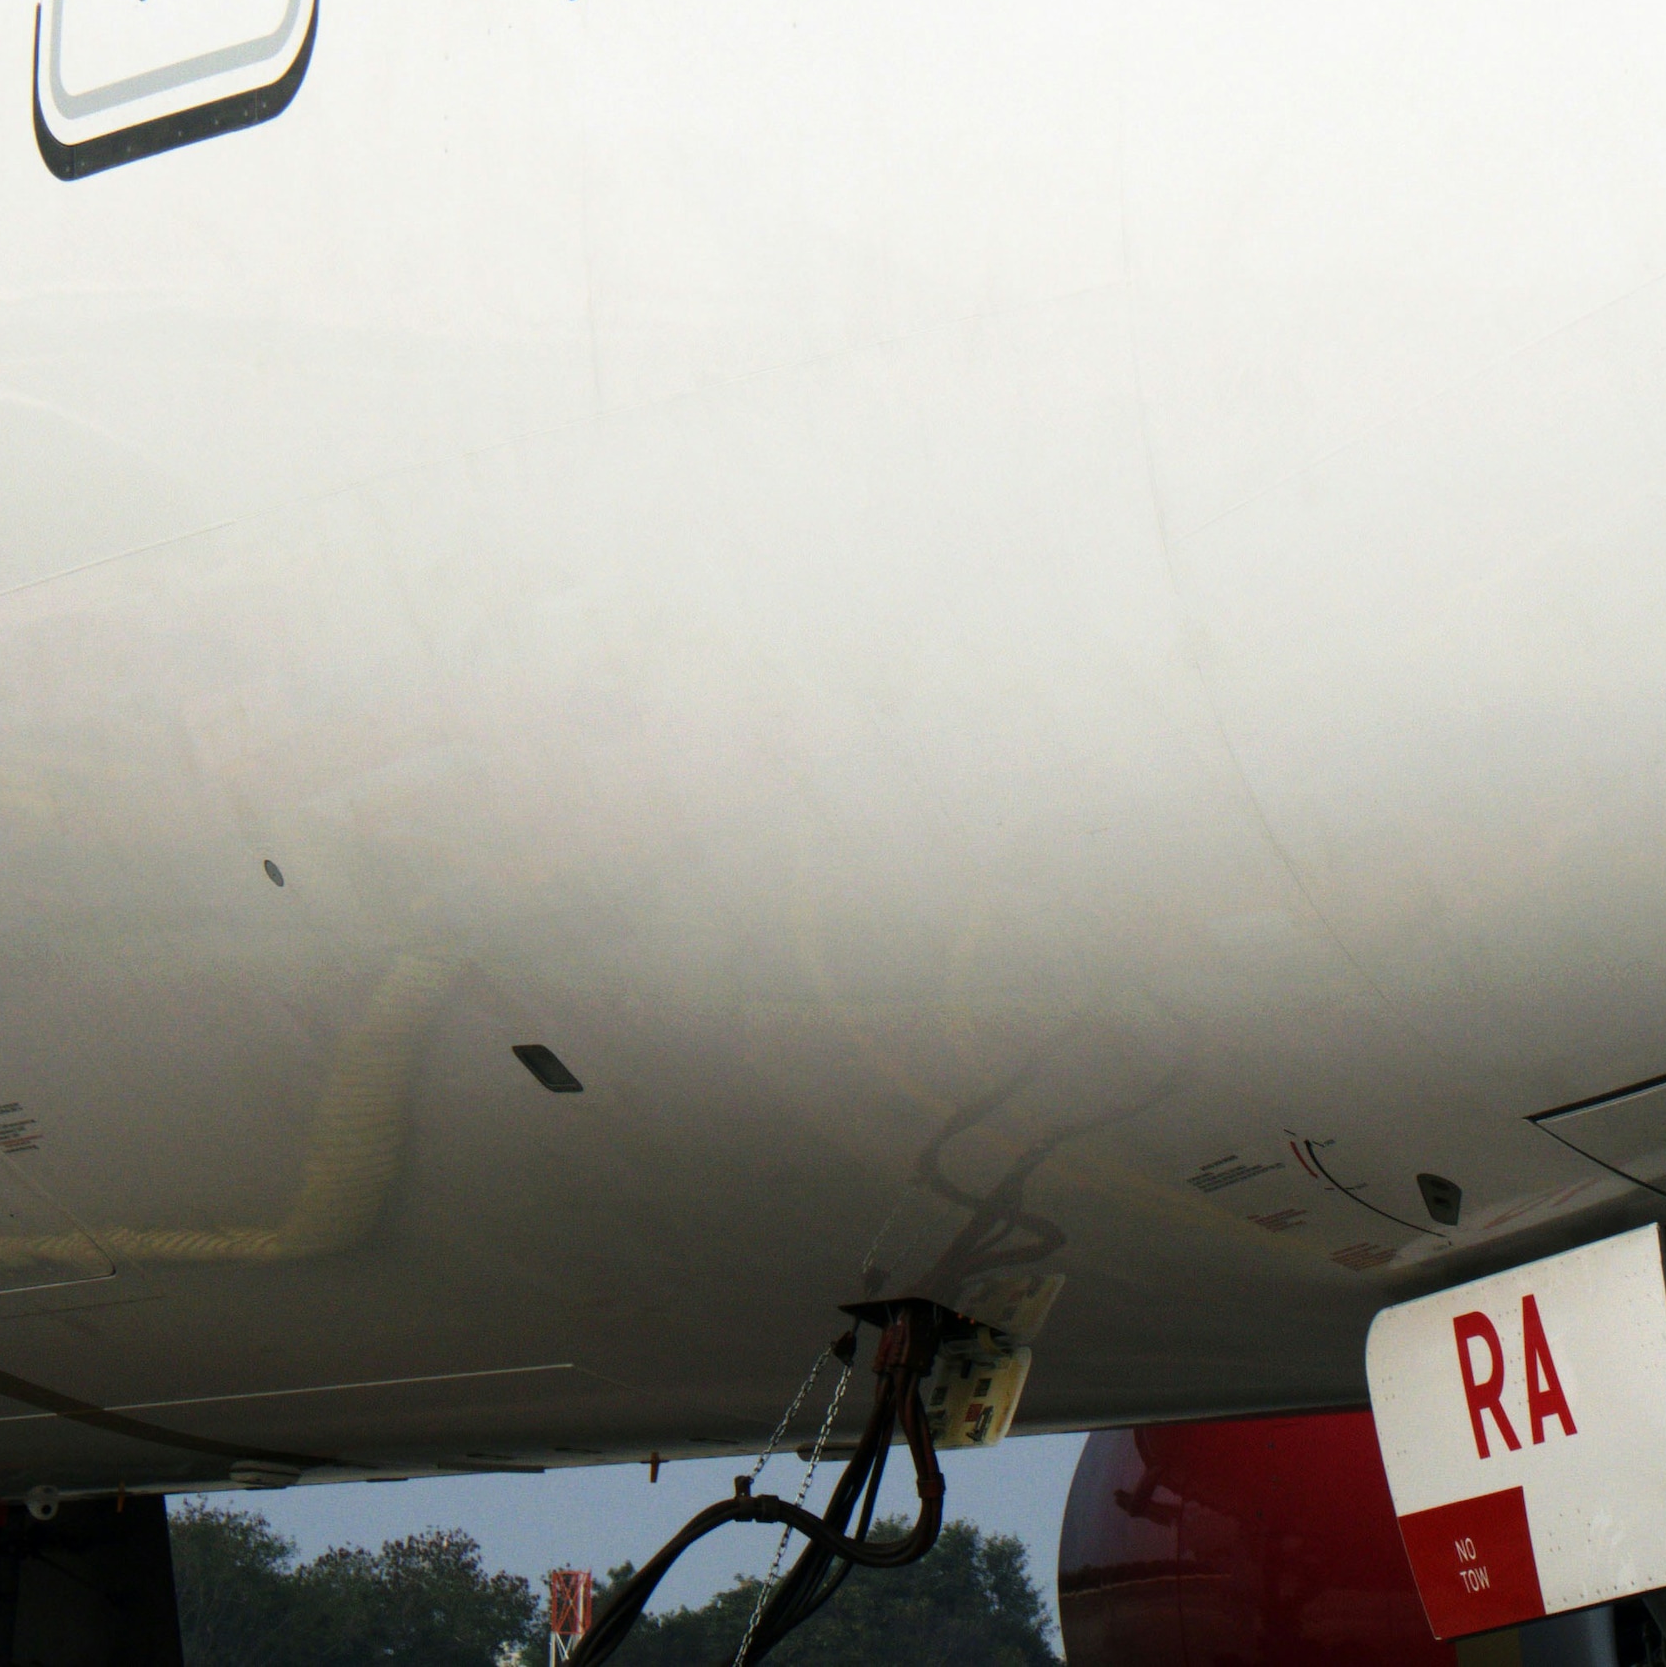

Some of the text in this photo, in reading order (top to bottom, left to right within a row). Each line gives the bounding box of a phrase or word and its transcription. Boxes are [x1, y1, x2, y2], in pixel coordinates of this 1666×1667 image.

[1452, 1293, 1578, 1460] RA
[1454, 1536, 1477, 1564] NO
[1459, 1565, 1491, 1594] TOW
